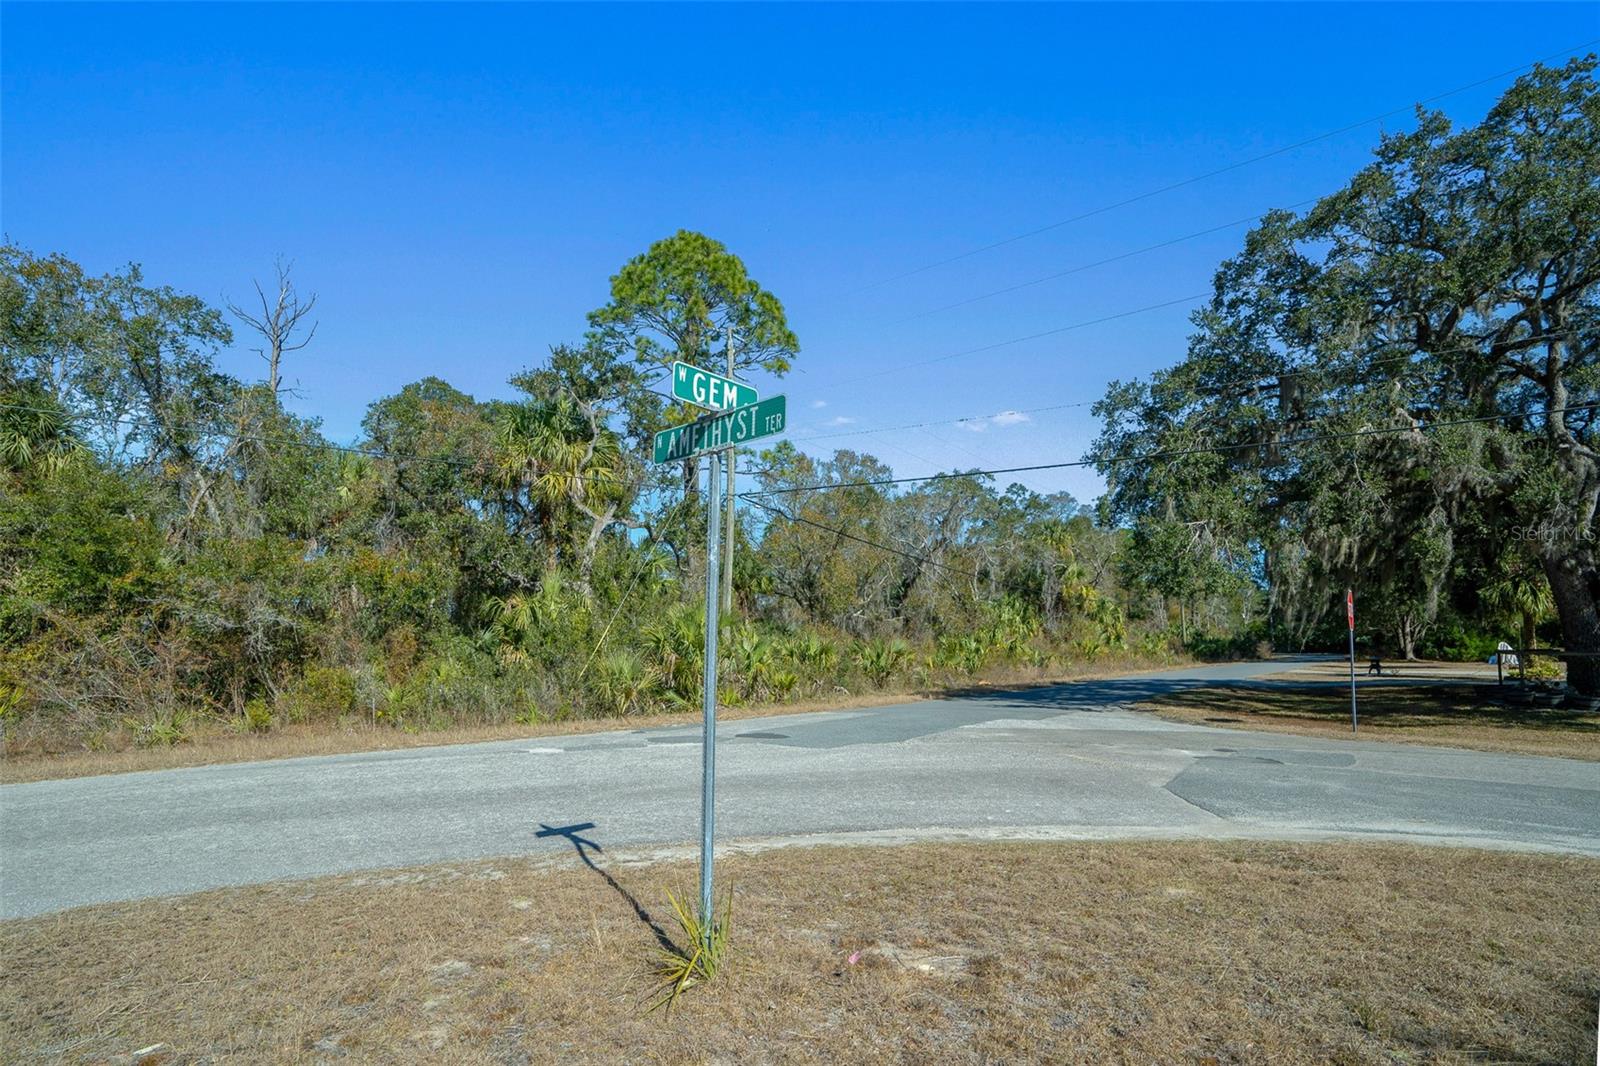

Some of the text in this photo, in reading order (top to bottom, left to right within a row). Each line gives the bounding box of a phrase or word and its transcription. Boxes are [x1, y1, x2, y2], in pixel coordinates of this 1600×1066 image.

[679, 365, 738, 411] W GEM
[657, 406, 782, 459] N AMETHYST TER
